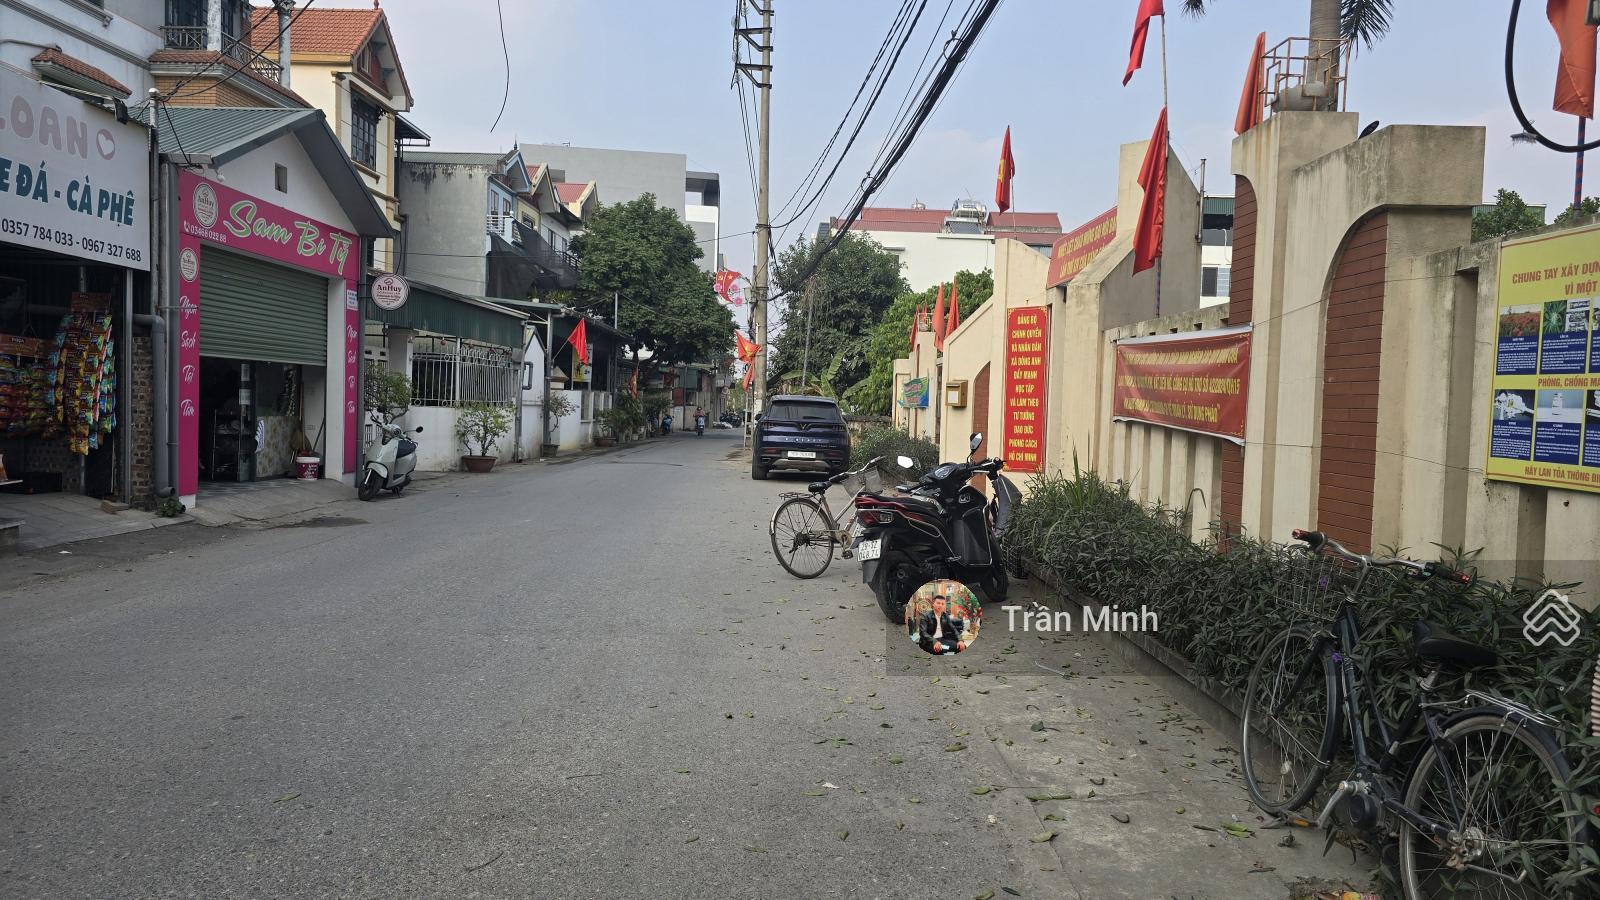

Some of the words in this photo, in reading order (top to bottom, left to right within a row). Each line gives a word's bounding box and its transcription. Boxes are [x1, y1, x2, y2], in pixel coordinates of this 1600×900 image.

[0, 95, 88, 160] OAN
[16, 160, 49, 204] ĐÁ
[67, 175, 93, 216] CÀ
[97, 190, 135, 227] PHÊ
[223, 199, 293, 246] Sam
[293, 219, 327, 257] Bi
[1, 218, 30, 237] 0357
[32, 224, 52, 242] 784
[54, 231, 74, 247] 033
[82, 236, 105, 254] 0967
[107, 243, 124, 258] 327
[125, 247, 142, 262] 688
[1512, 270, 1542, 284] CHUNG
[1544, 267, 1559, 280] TAY
[1561, 263, 1579, 278] XÂY
[377, 284, 403, 293] AnHuy
[1565, 281, 1574, 296] VÌ
[1576, 279, 1598, 296] MỘT
[1564, 374, 1589, 387] CHỐNG
[1524, 465, 1538, 476] HÃY
[1538, 467, 1552, 477] LAN
[1567, 469, 1590, 481] THÔNG
